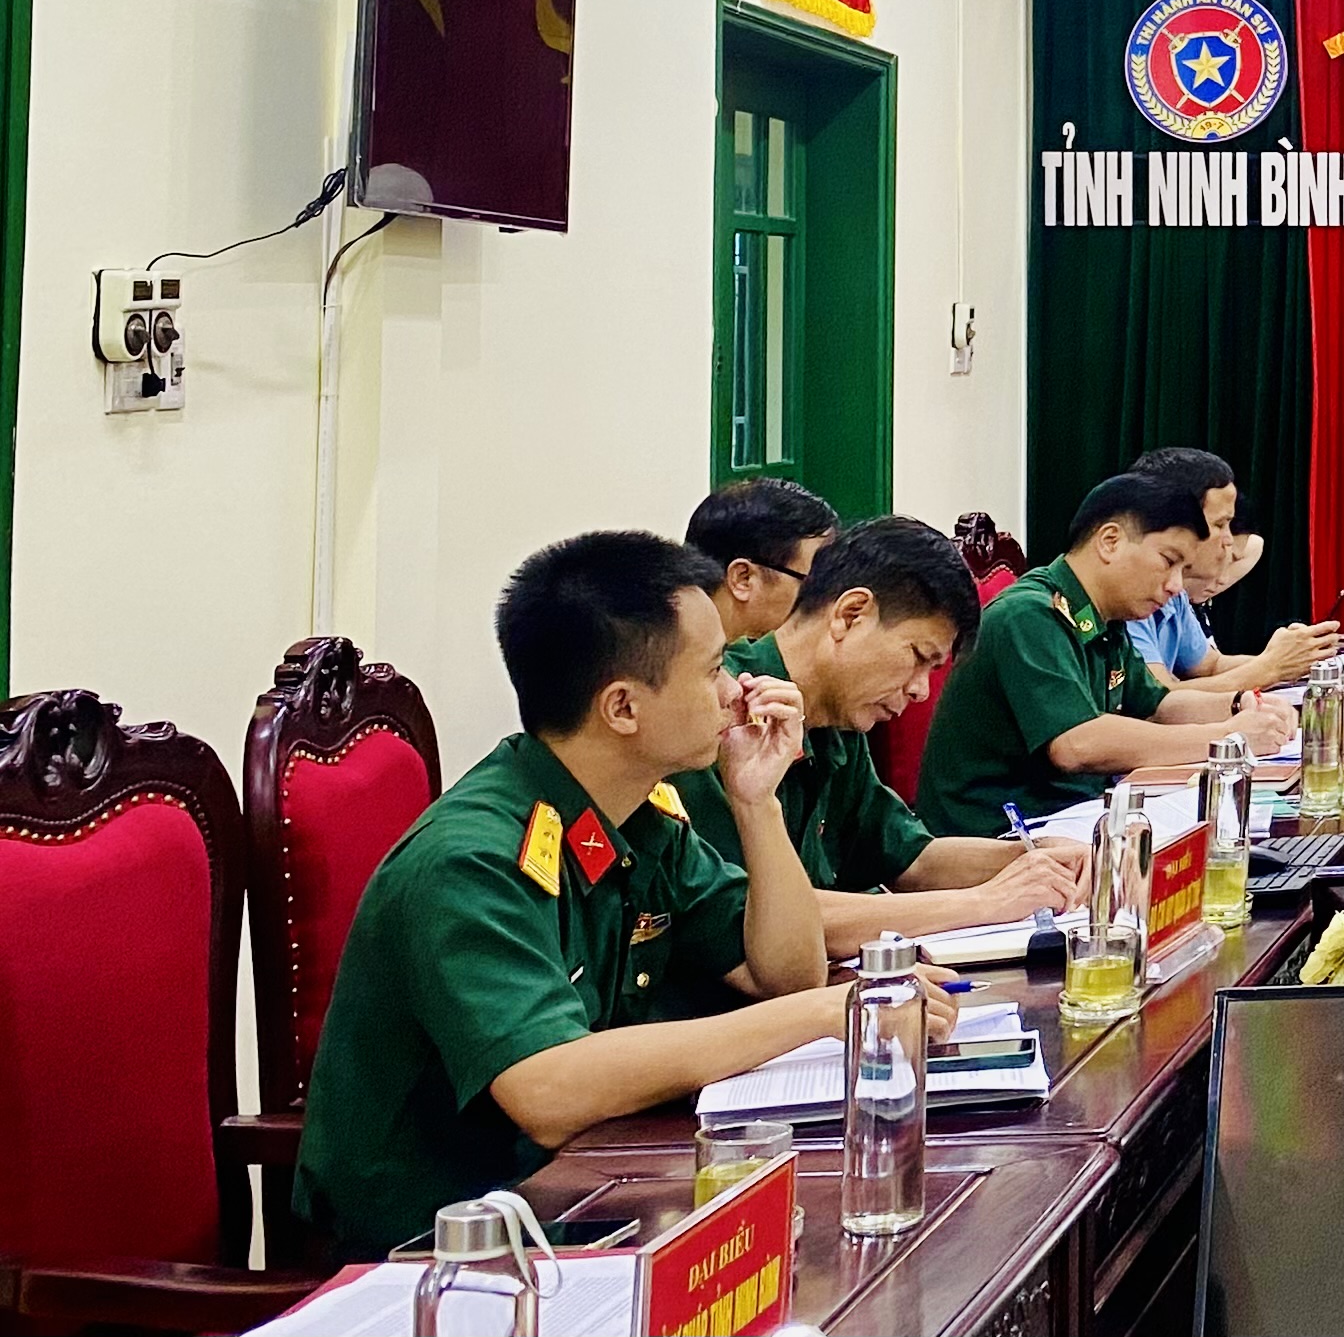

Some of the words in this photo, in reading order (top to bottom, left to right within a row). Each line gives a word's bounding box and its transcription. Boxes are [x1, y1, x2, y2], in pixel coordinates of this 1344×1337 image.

[1137, 21, 1156, 45] THI
[1041, 122, 1134, 227] TỈNH
[1148, 152, 1248, 227] NINH
